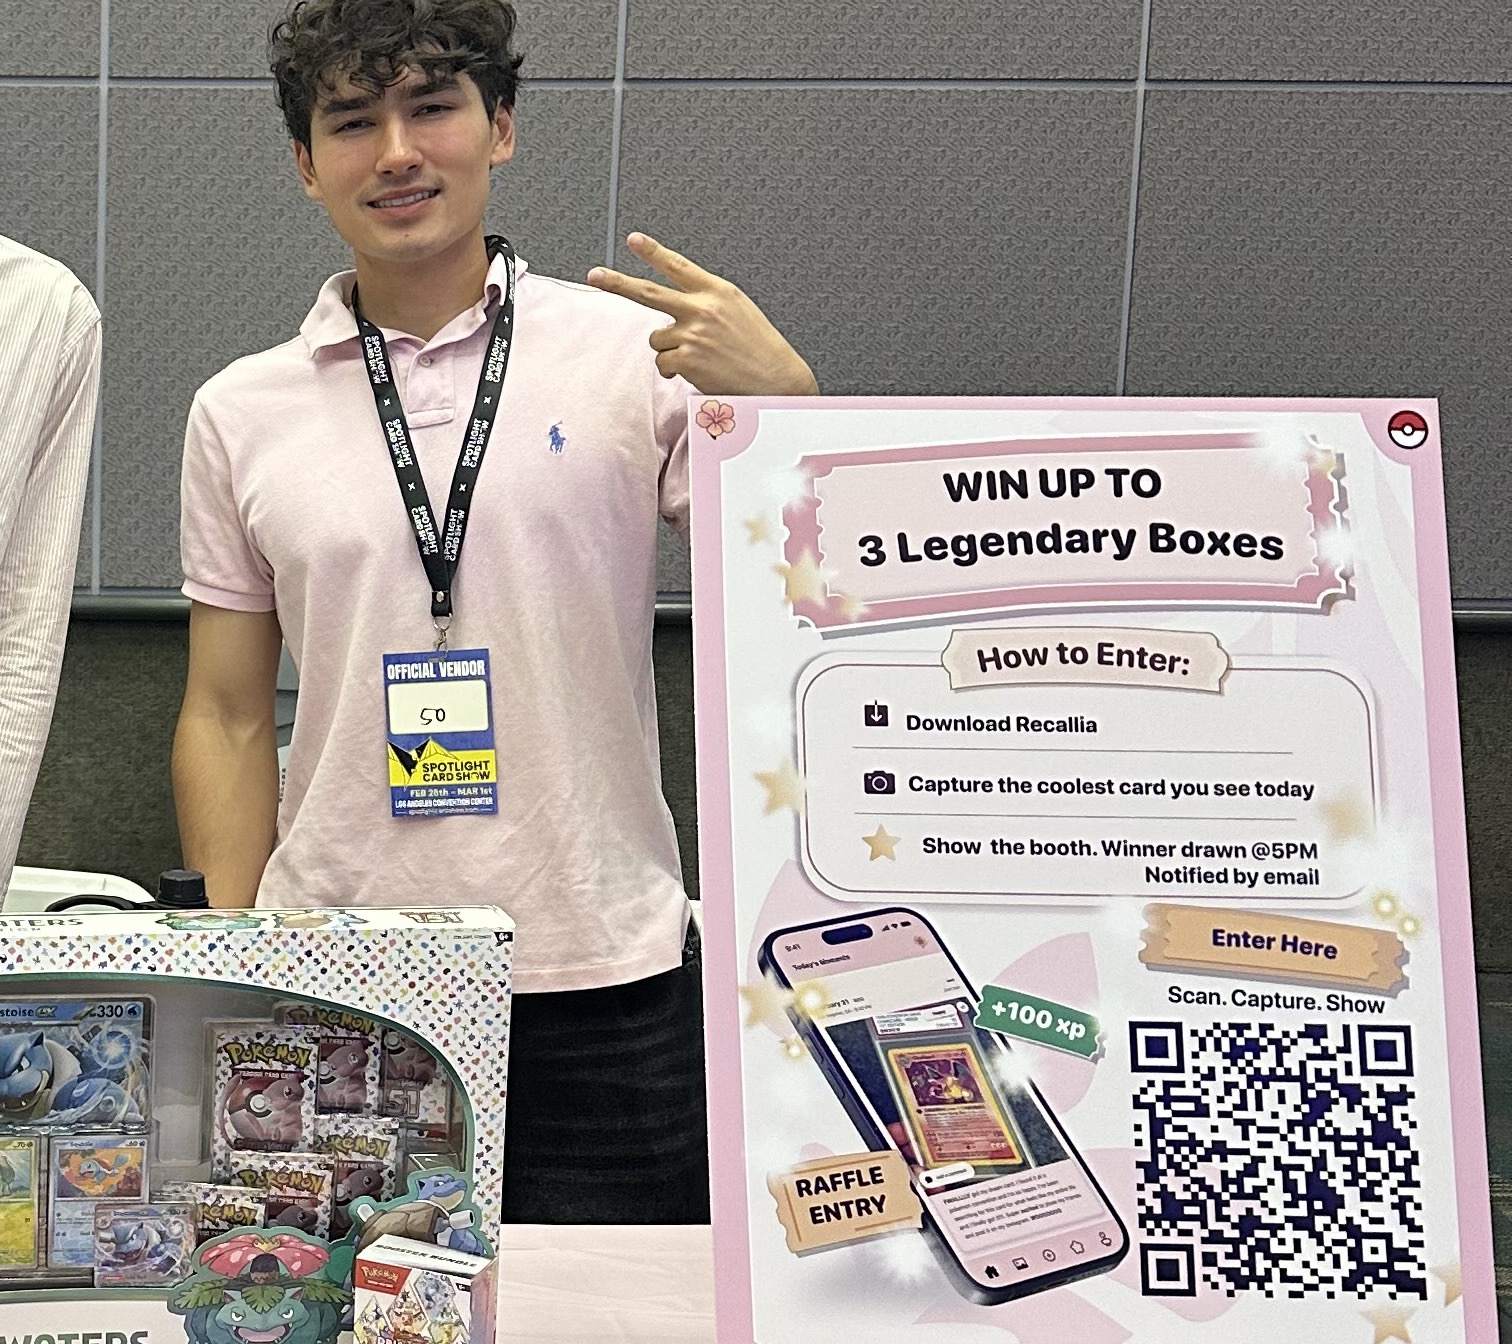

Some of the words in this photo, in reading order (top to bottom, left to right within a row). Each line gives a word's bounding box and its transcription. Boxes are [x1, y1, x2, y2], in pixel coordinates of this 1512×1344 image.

[944, 469, 1028, 503] WIN
[1039, 468, 1095, 499] UP
[1105, 468, 1162, 498] TO
[858, 535, 886, 567] 3
[898, 522, 1137, 566] Legendary
[1148, 522, 1285, 560] Boxes
[387, 662, 436, 680] OFFICIAL
[439, 659, 485, 678] VENDOR
[977, 645, 1050, 673] How
[1056, 642, 1088, 665] to
[1097, 643, 1190, 676] Enter:
[906, 714, 1011, 732] Download
[1016, 716, 1098, 733] Recallia
[422, 760, 490, 773] SPOTLIGHT
[423, 771, 454, 782] CARD
[410, 789, 426, 797] FEB
[457, 787, 478, 796] MAR
[908, 775, 993, 796] Capture
[997, 777, 1032, 793] the
[1037, 778, 1114, 795] coolest
[1119, 779, 1166, 795] card
[1171, 782, 1209, 800] you
[1213, 783, 1250, 797] see
[1255, 781, 1315, 801] today
[923, 837, 982, 854] Show
[990, 838, 1025, 855] the
[1029, 839, 1098, 856] booth.
[1101, 840, 1177, 858] Winner
[1181, 841, 1247, 858] drawn
[1251, 842, 1318, 860] @5PM
[1145, 866, 1229, 884] Notified
[1233, 867, 1259, 888] by
[1264, 868, 1320, 885] email
[1212, 927, 1277, 951] Enter
[1280, 933, 1339, 960] Here
[96, 1005, 124, 1018] 330
[1168, 986, 1227, 1007] Scan.
[1231, 988, 1323, 1012] Capture.
[1326, 994, 1386, 1015] Show
[991, 999, 1054, 1030] +100
[1056, 1016, 1087, 1041] xp
[795, 1165, 885, 1198] RAFFLE
[808, 1194, 886, 1225] ENTRY
[374, 1243, 431, 1259] BOOSTER
[429, 1255, 478, 1269] BUNDLE
